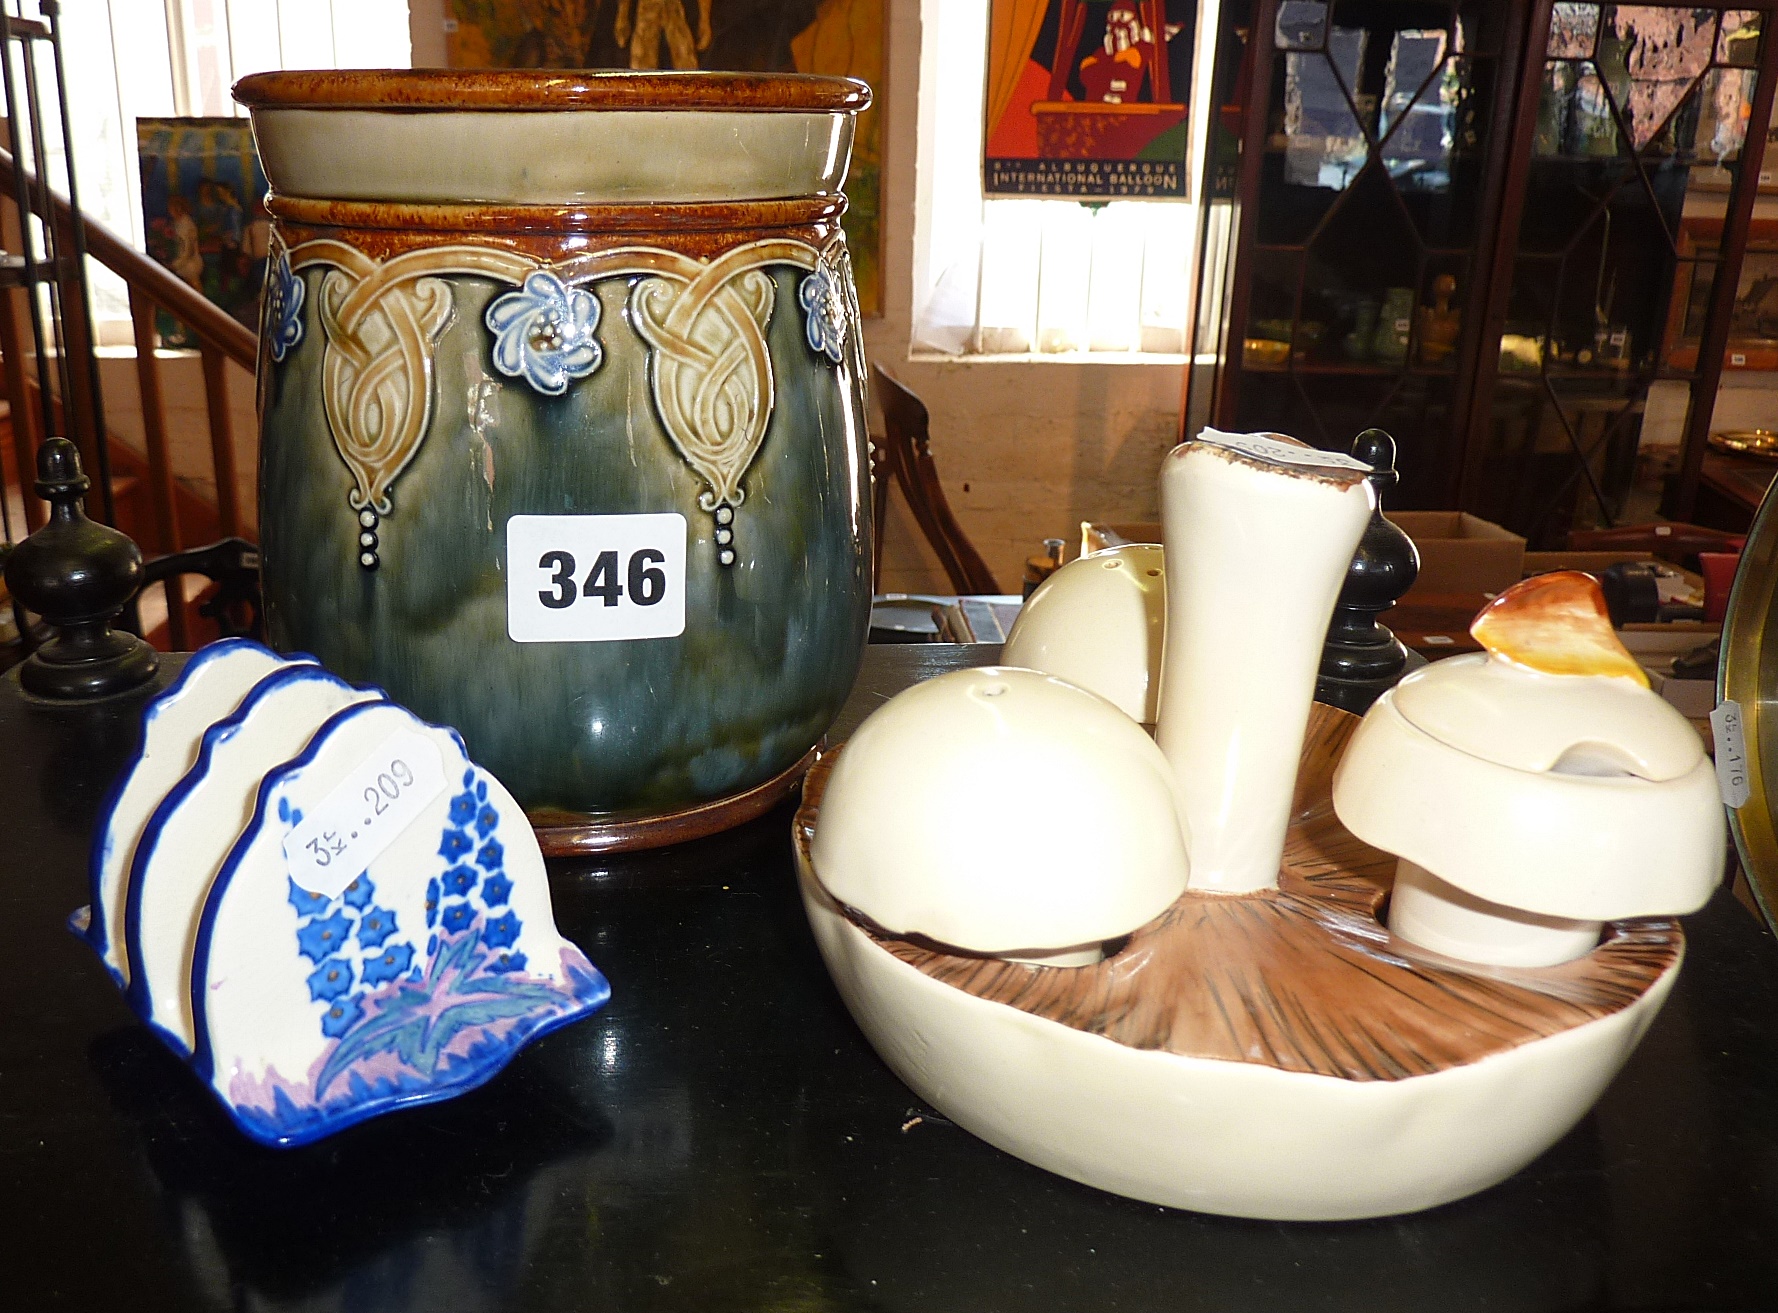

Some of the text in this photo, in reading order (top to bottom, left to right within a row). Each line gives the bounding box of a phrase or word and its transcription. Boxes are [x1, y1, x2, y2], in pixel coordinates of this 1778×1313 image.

[1039, 162, 1176, 174] ALBUQUERQUE
[993, 172, 1177, 190] INTERNATIONAL BALLOON
[538, 548, 666, 609] 346
